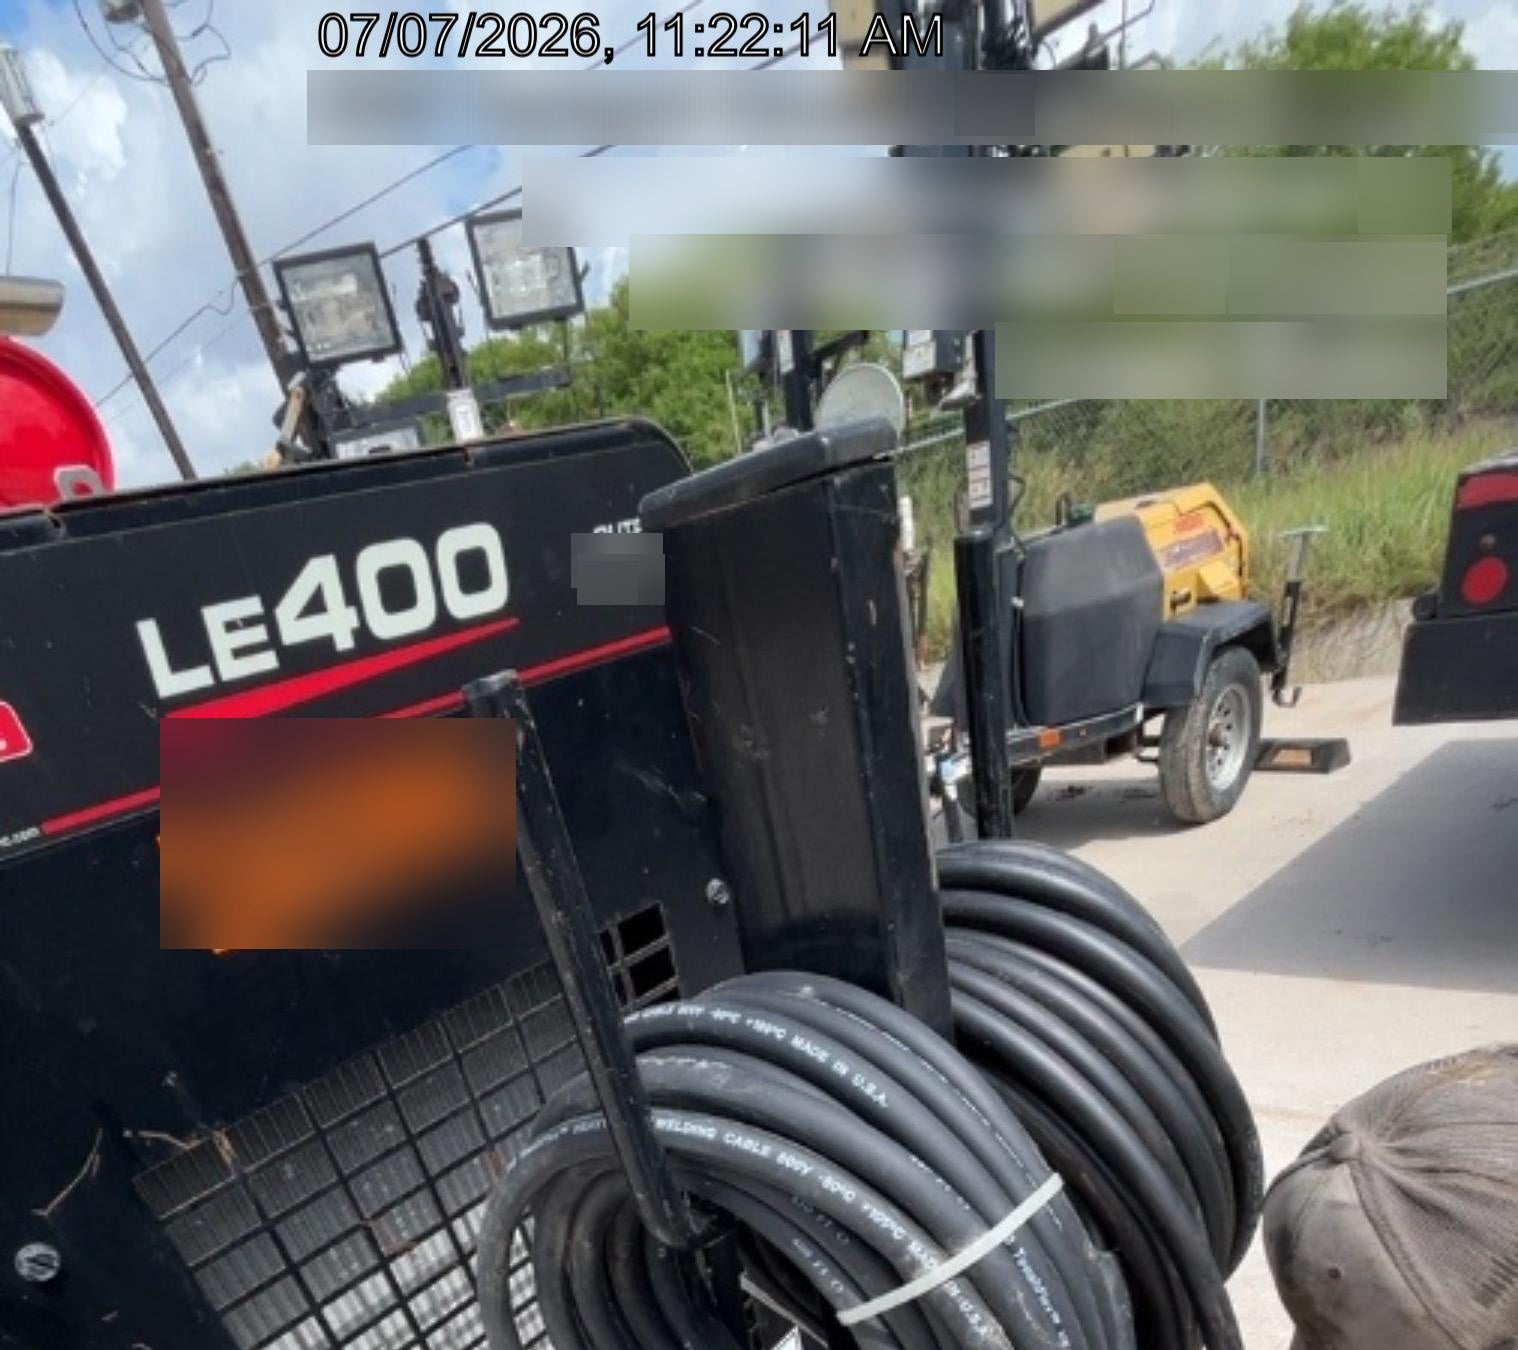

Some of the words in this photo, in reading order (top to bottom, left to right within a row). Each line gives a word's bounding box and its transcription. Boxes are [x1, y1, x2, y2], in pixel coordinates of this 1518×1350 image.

[136, 521, 509, 700] LE400
[655, 1117, 718, 1141] WELDING
[722, 1130, 773, 1159] CABLE
